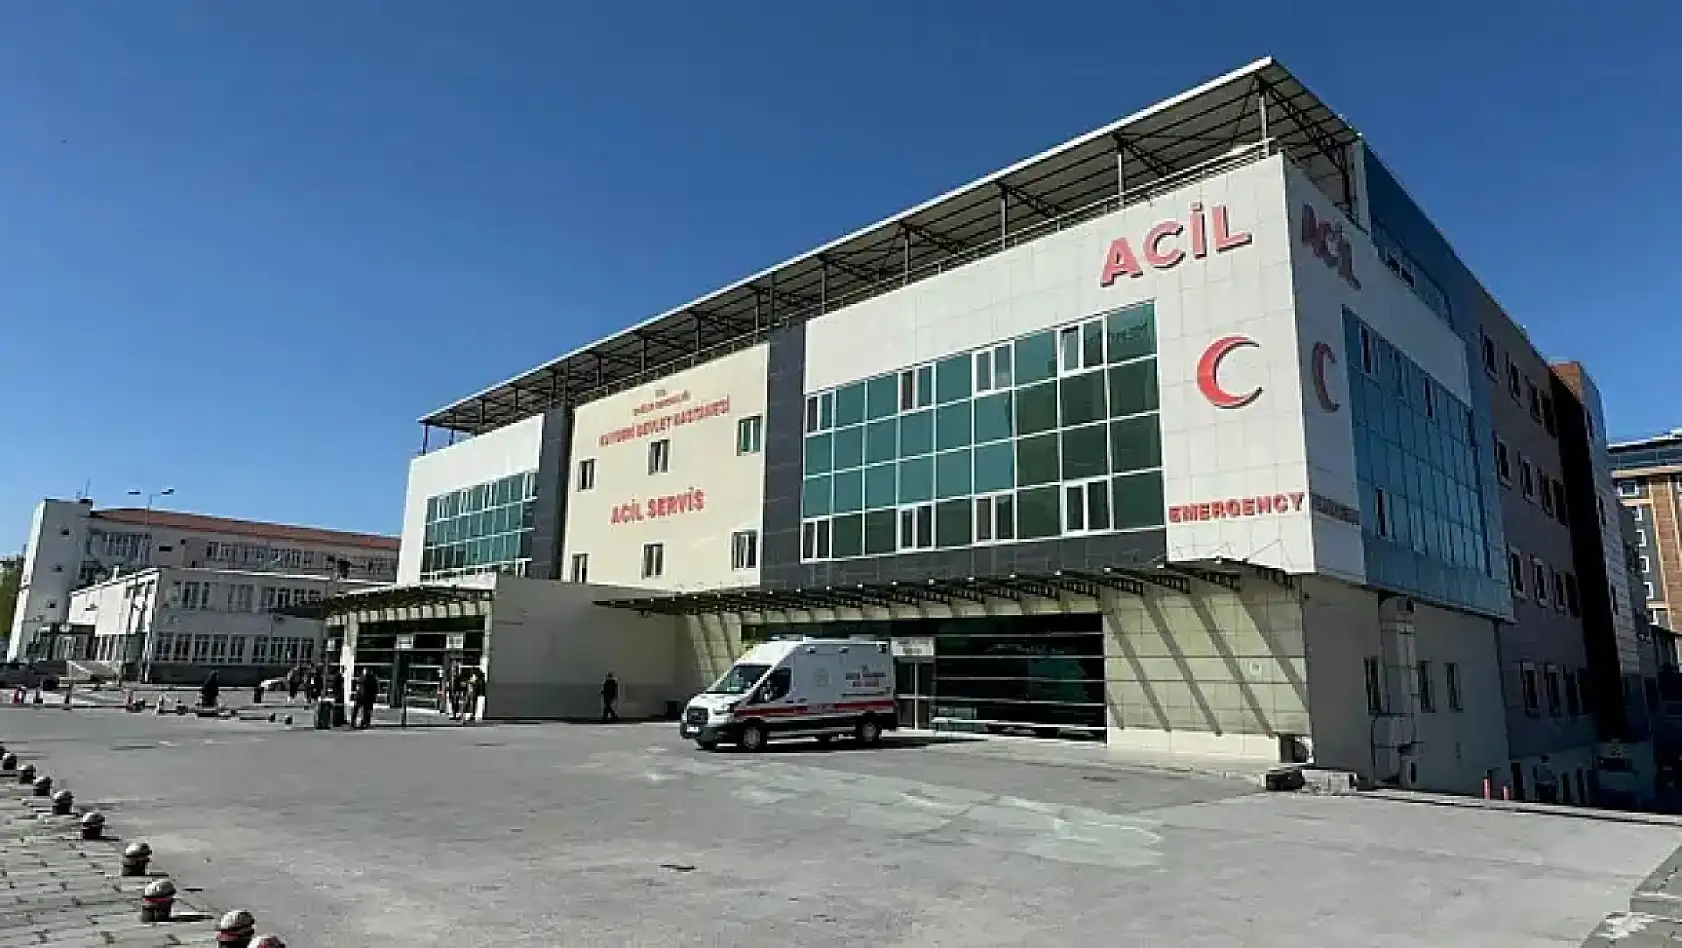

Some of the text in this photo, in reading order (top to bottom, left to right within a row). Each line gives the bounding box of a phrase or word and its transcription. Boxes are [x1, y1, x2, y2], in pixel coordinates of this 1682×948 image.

[1100, 202, 1252, 287] ACİL
[610, 486, 705, 525] ACİL SERVİS
[1168, 491, 1305, 523] EMERGENCY
